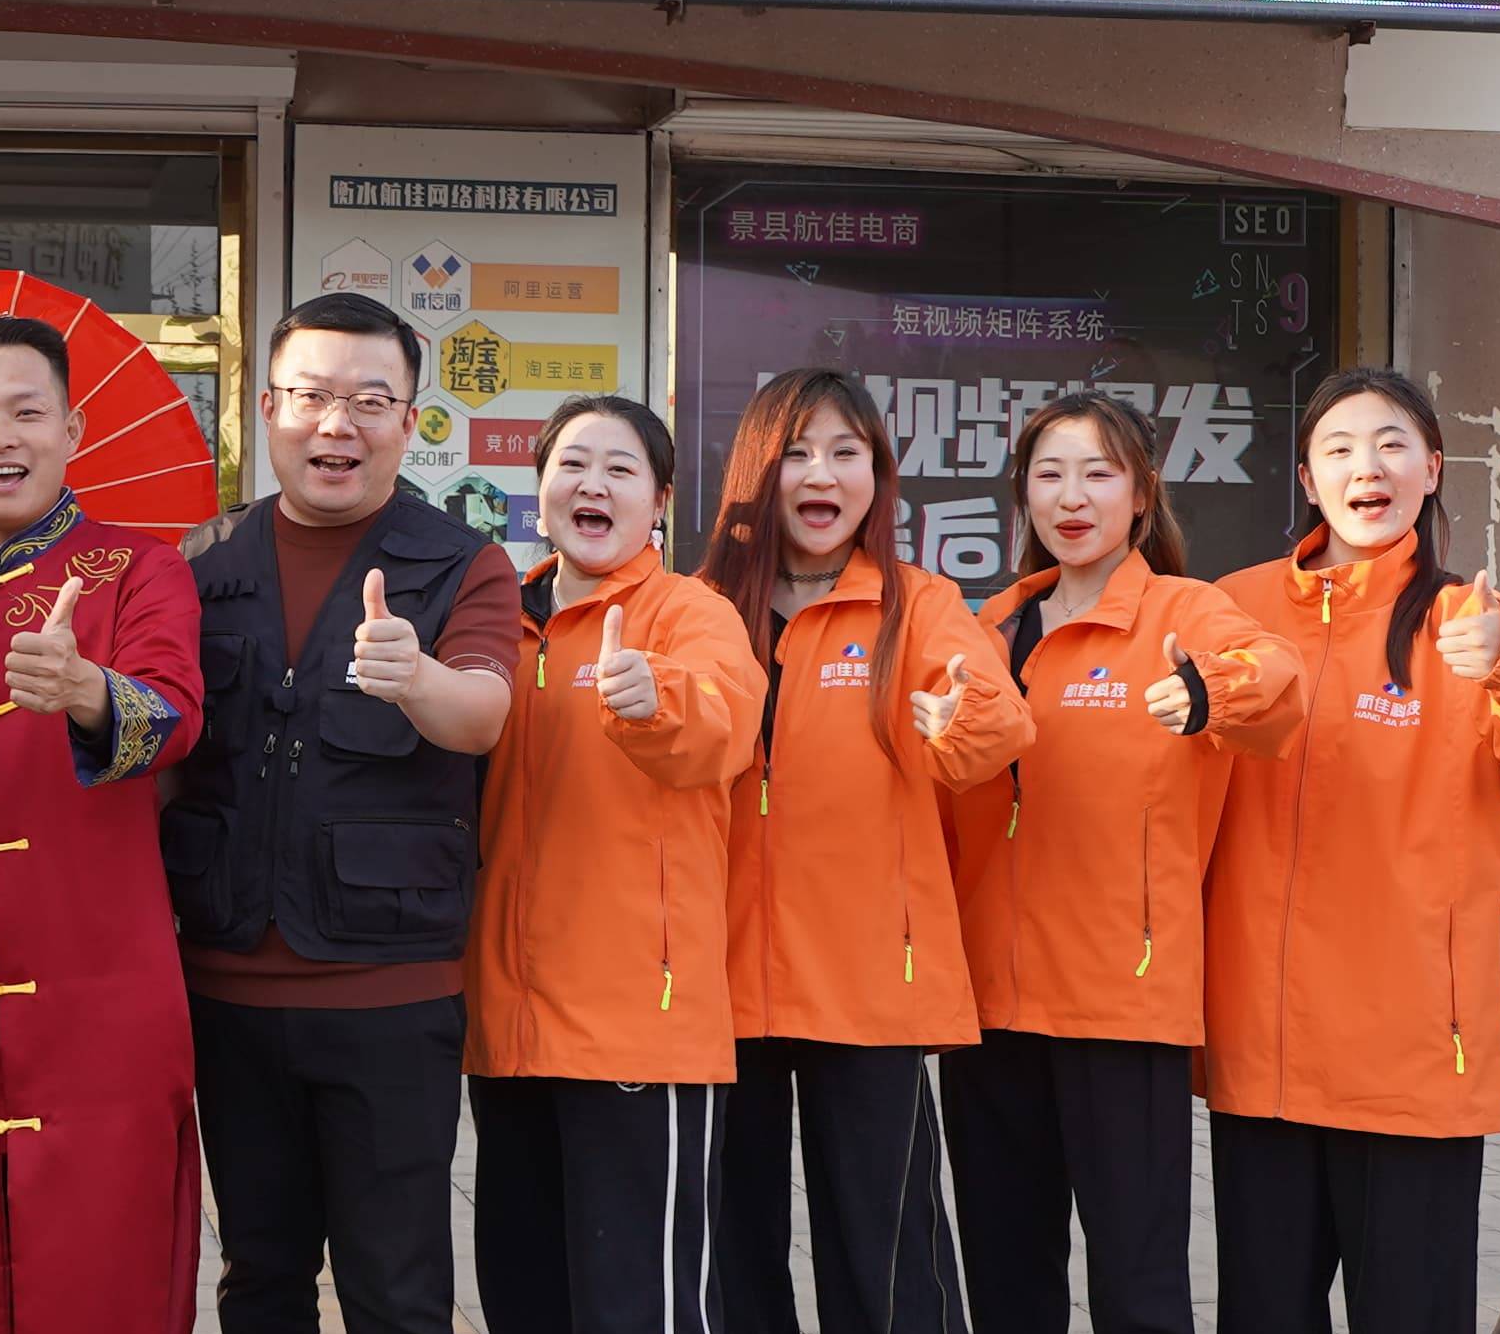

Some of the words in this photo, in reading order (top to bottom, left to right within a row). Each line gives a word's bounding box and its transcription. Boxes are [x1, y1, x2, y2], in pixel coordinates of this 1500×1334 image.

[332, 179, 616, 213] 衡水航佳网络科技有限公司
[728, 210, 921, 246] 景县航佳电商
[1234, 204, 1291, 235] SEO
[411, 291, 462, 312] 诚信通
[503, 280, 585, 301] 阿里运营
[892, 303, 1106, 343] 短视频矩阵系统
[525, 359, 607, 381] 淘宝运营
[406, 449, 463, 468] 360推广
